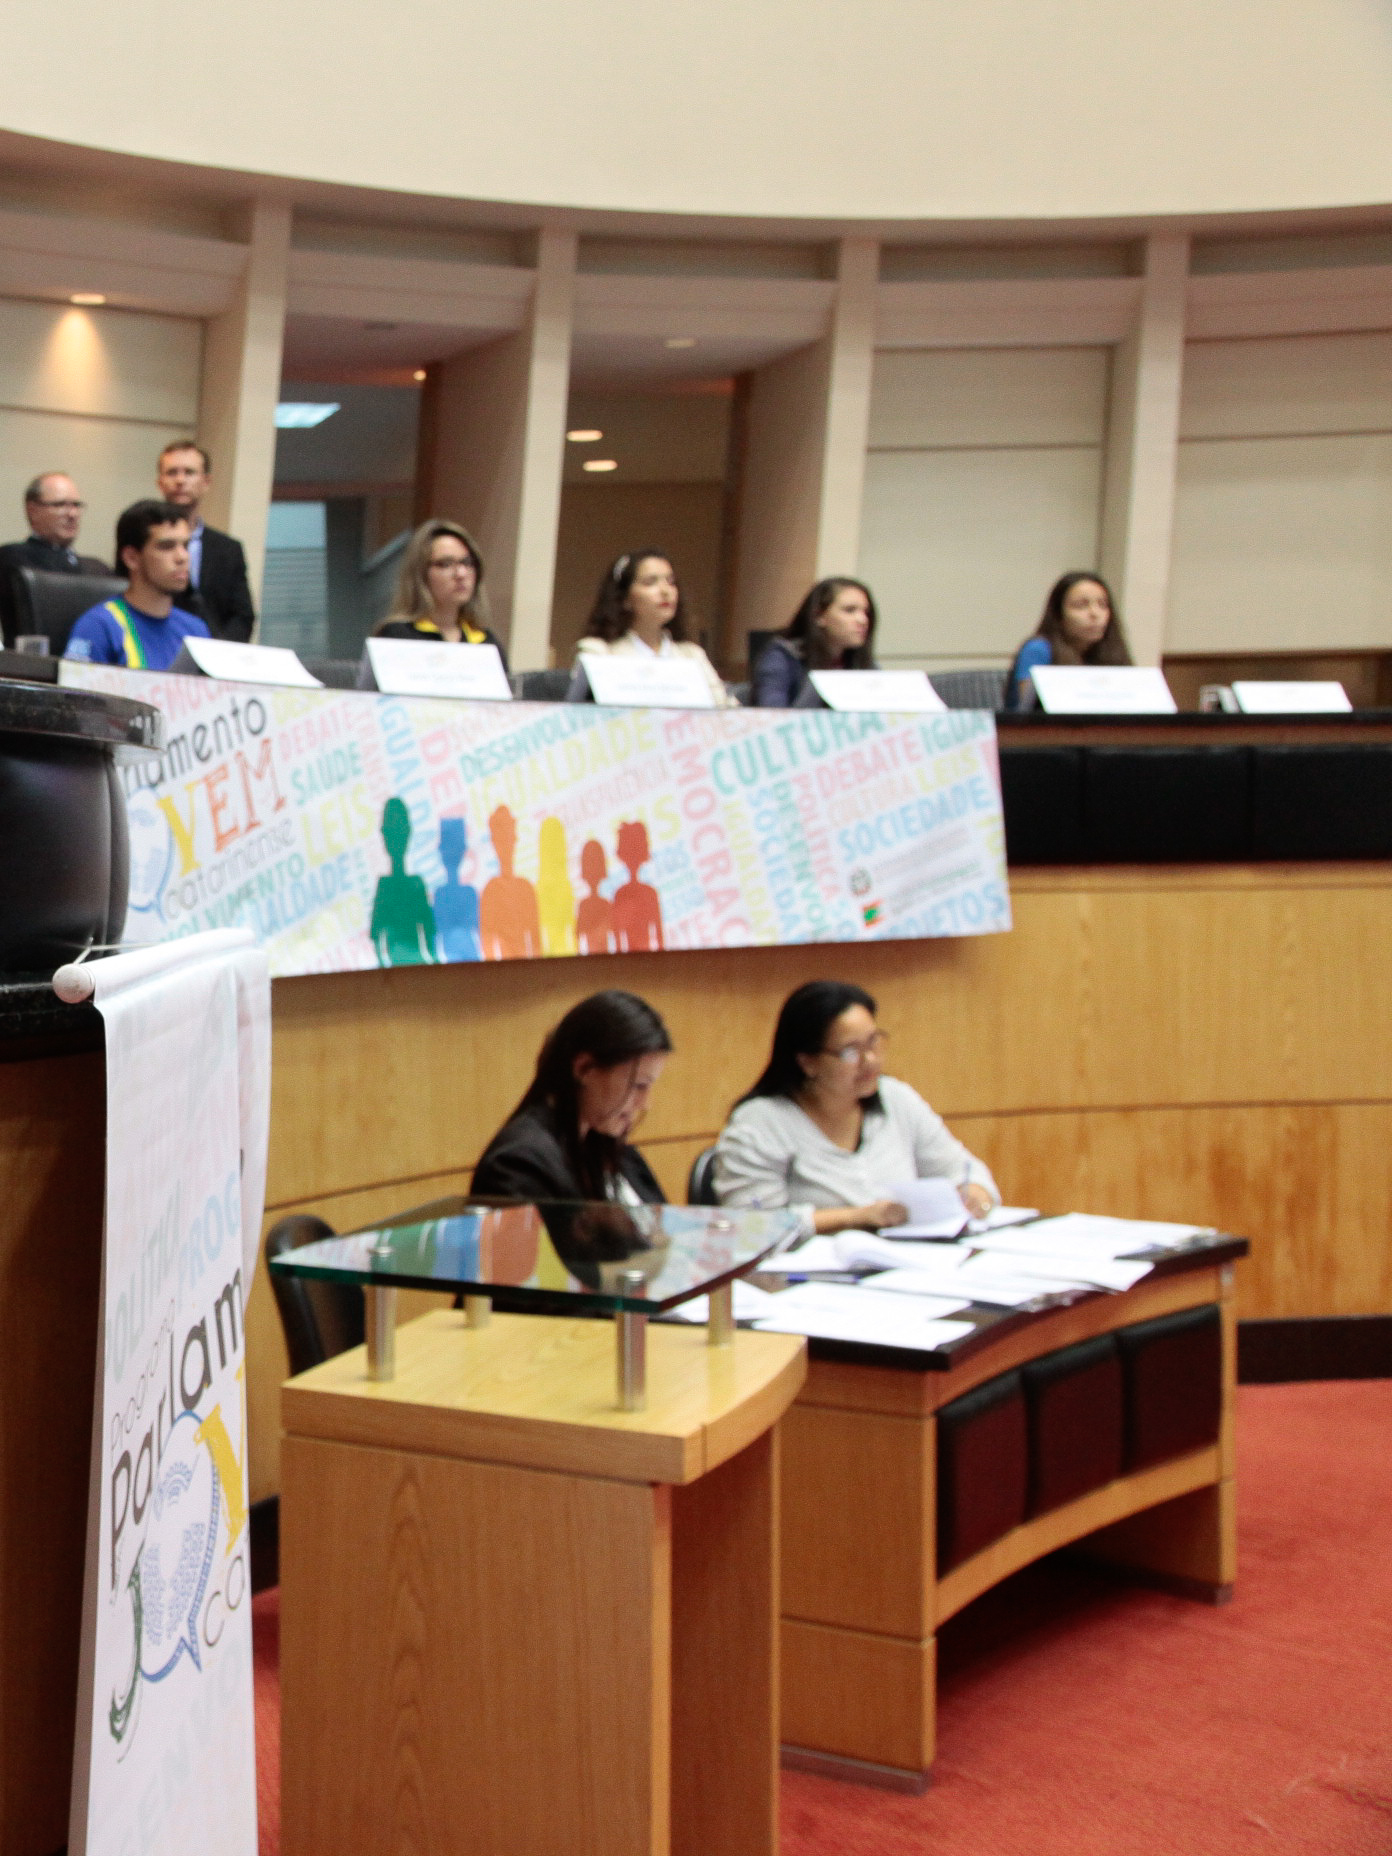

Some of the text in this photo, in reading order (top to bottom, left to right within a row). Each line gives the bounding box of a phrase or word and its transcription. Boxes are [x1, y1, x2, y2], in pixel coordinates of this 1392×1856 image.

[277, 700, 358, 762] DEBATE
[711, 711, 885, 796] CULTURA
[815, 729, 923, 799] DEBATE
[915, 745, 980, 793] LEIS
[300, 783, 376, 868] LEIS
[838, 775, 994, 864] SOCIEDADE
